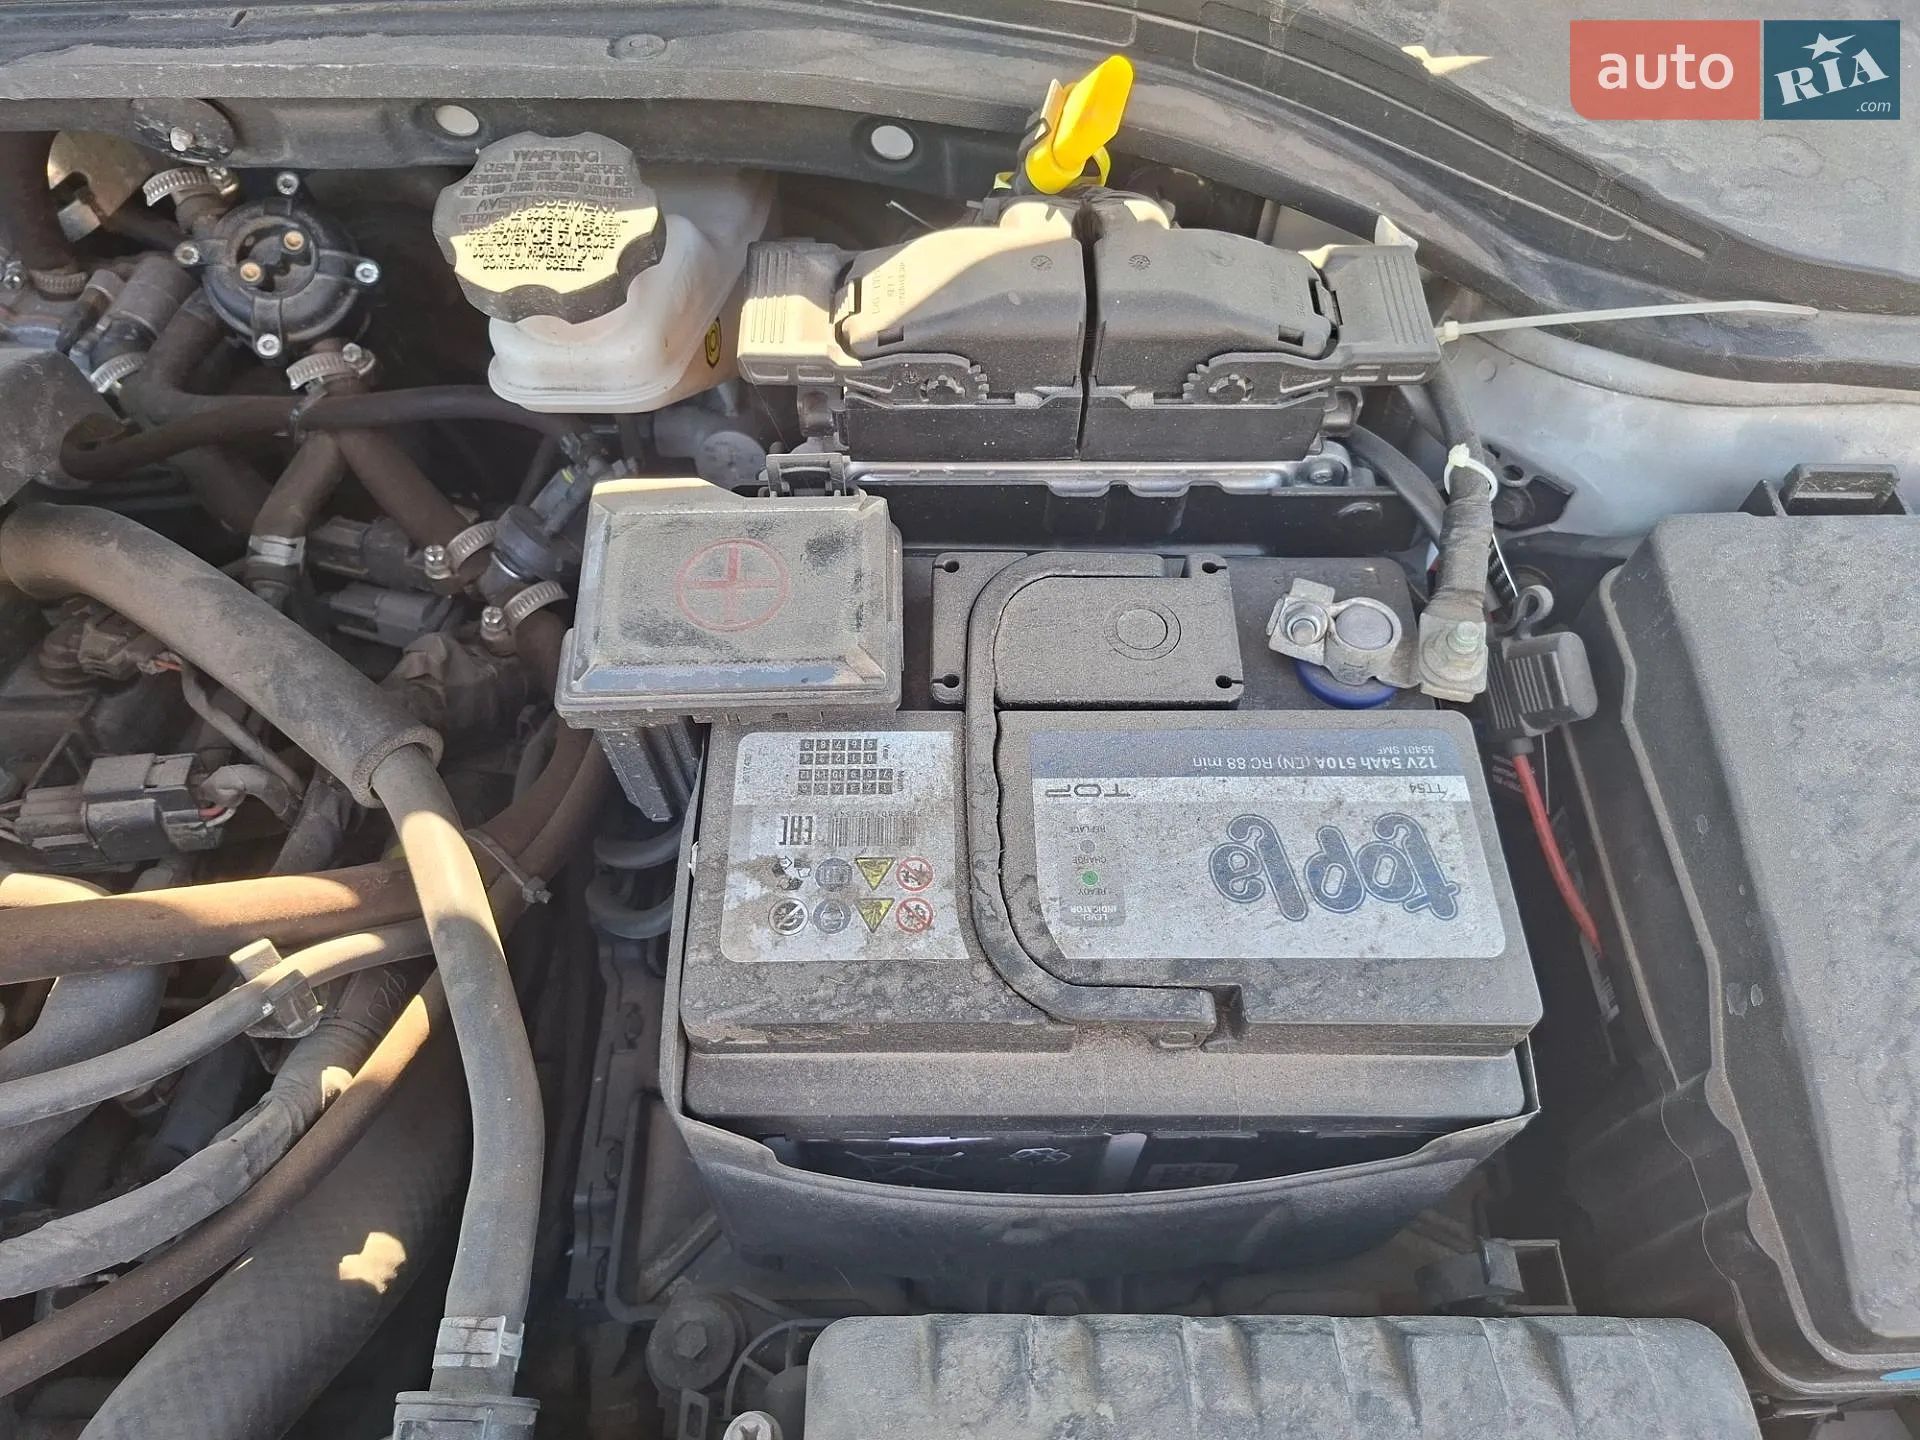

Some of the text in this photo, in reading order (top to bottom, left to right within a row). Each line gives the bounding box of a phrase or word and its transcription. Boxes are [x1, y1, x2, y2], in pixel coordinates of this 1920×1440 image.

[513, 149, 600, 162] WARNING
[1403, 745, 1434, 754] 55401
[1192, 757, 1222, 771] min
[1226, 757, 1246, 770] 88
[1251, 756, 1273, 770] RC
[1315, 756, 1356, 769] 510A
[1360, 756, 1401, 769] 54Ah
[1407, 756, 1437, 769] 12V
[1044, 783, 1131, 799] TOP
[1408, 783, 1446, 794] TT54
[1070, 825, 1106, 833] REPLACE
[1072, 855, 1107, 864] CHARGE
[1208, 813, 1460, 922] topla
[1078, 888, 1106, 896] READY
[1069, 904, 1117, 914] INDICATOR
